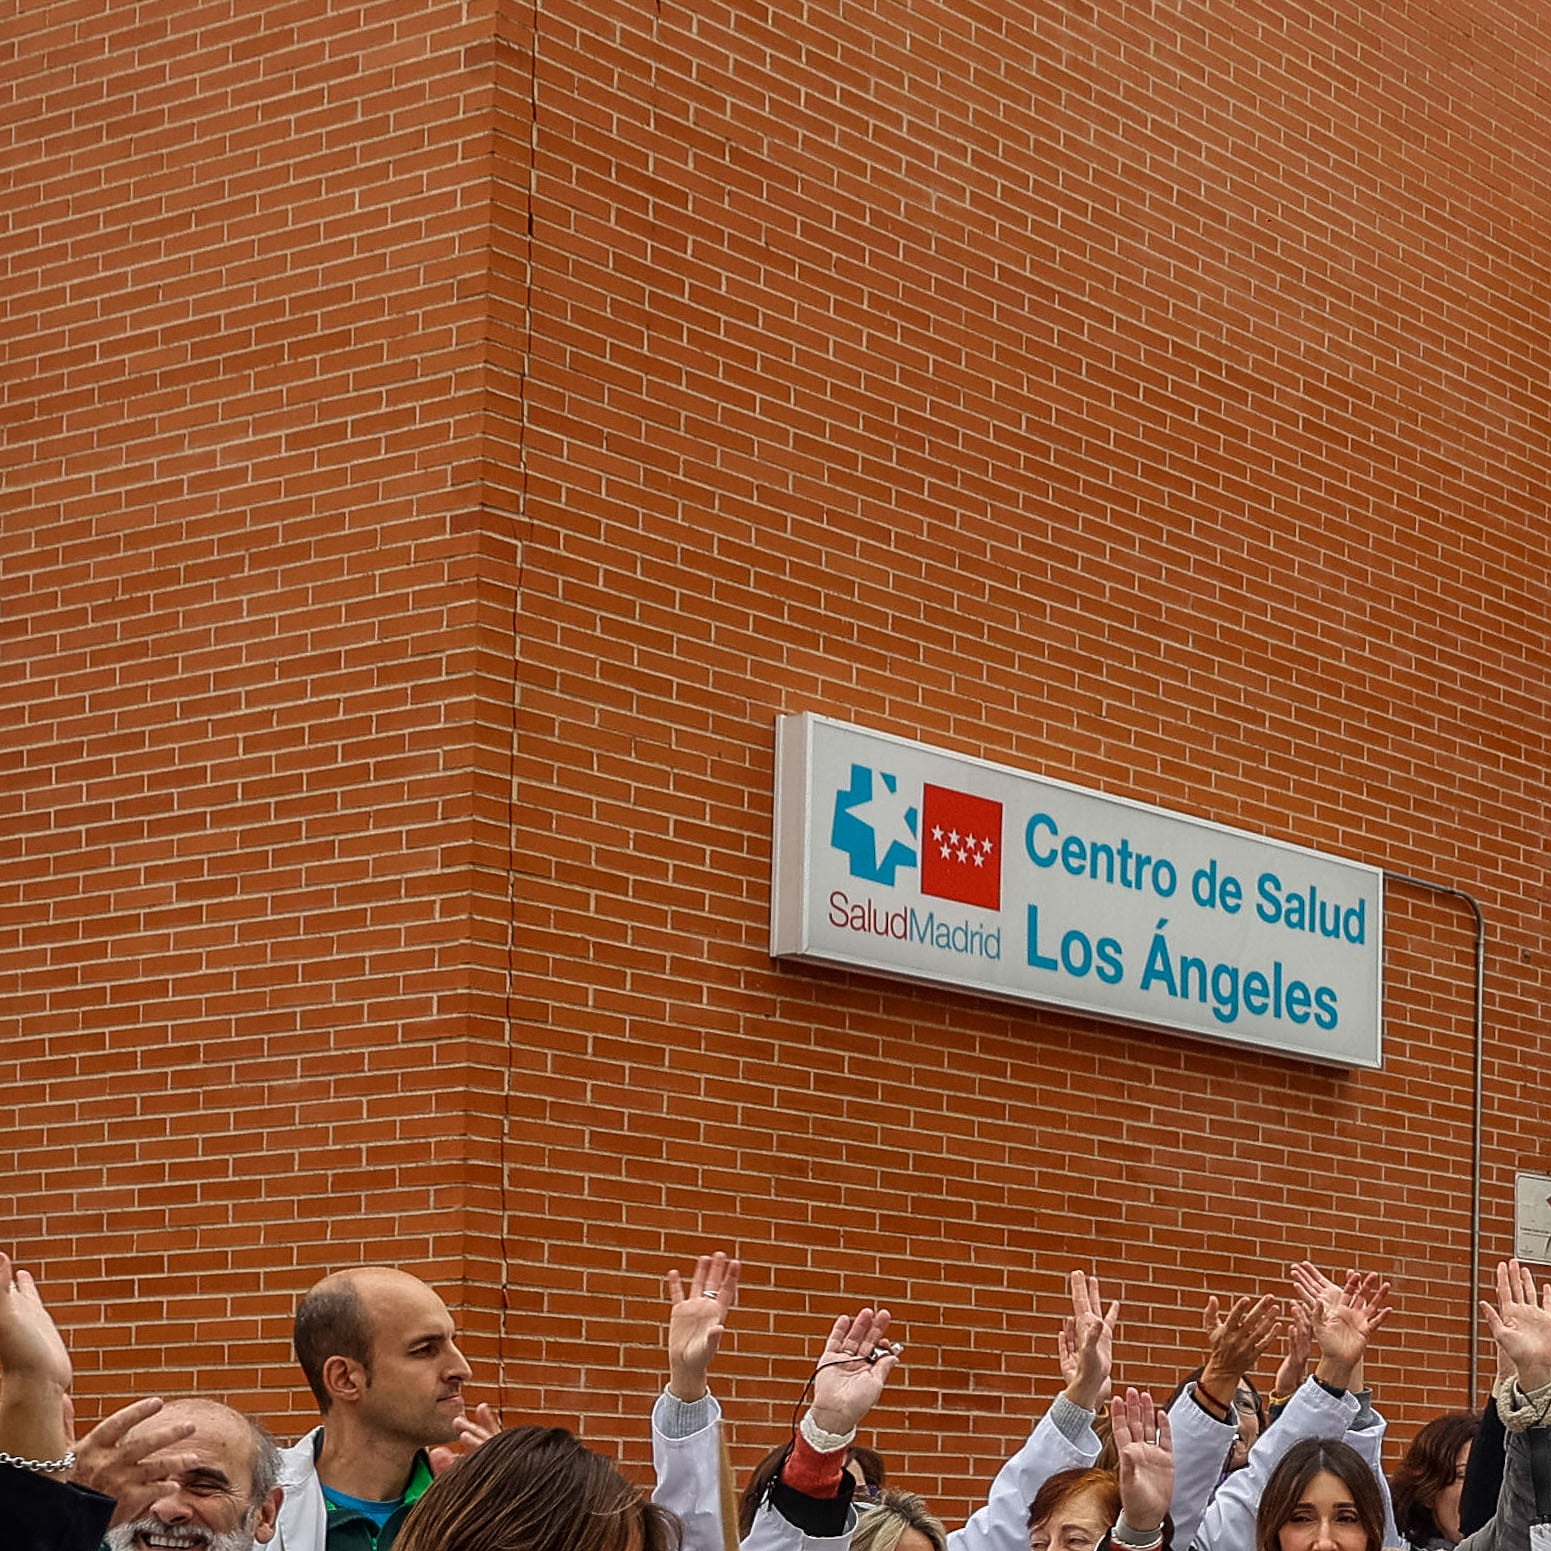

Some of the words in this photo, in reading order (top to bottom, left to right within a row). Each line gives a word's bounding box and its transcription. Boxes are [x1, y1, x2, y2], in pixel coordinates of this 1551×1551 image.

[829, 891, 1001, 960] SaludMadrid
[1025, 813, 1177, 897] Centro
[1192, 860, 1243, 914] de
[1256, 872, 1365, 945] Salud
[1027, 904, 1124, 985] Los
[1140, 918, 1341, 1030] Ángeles
